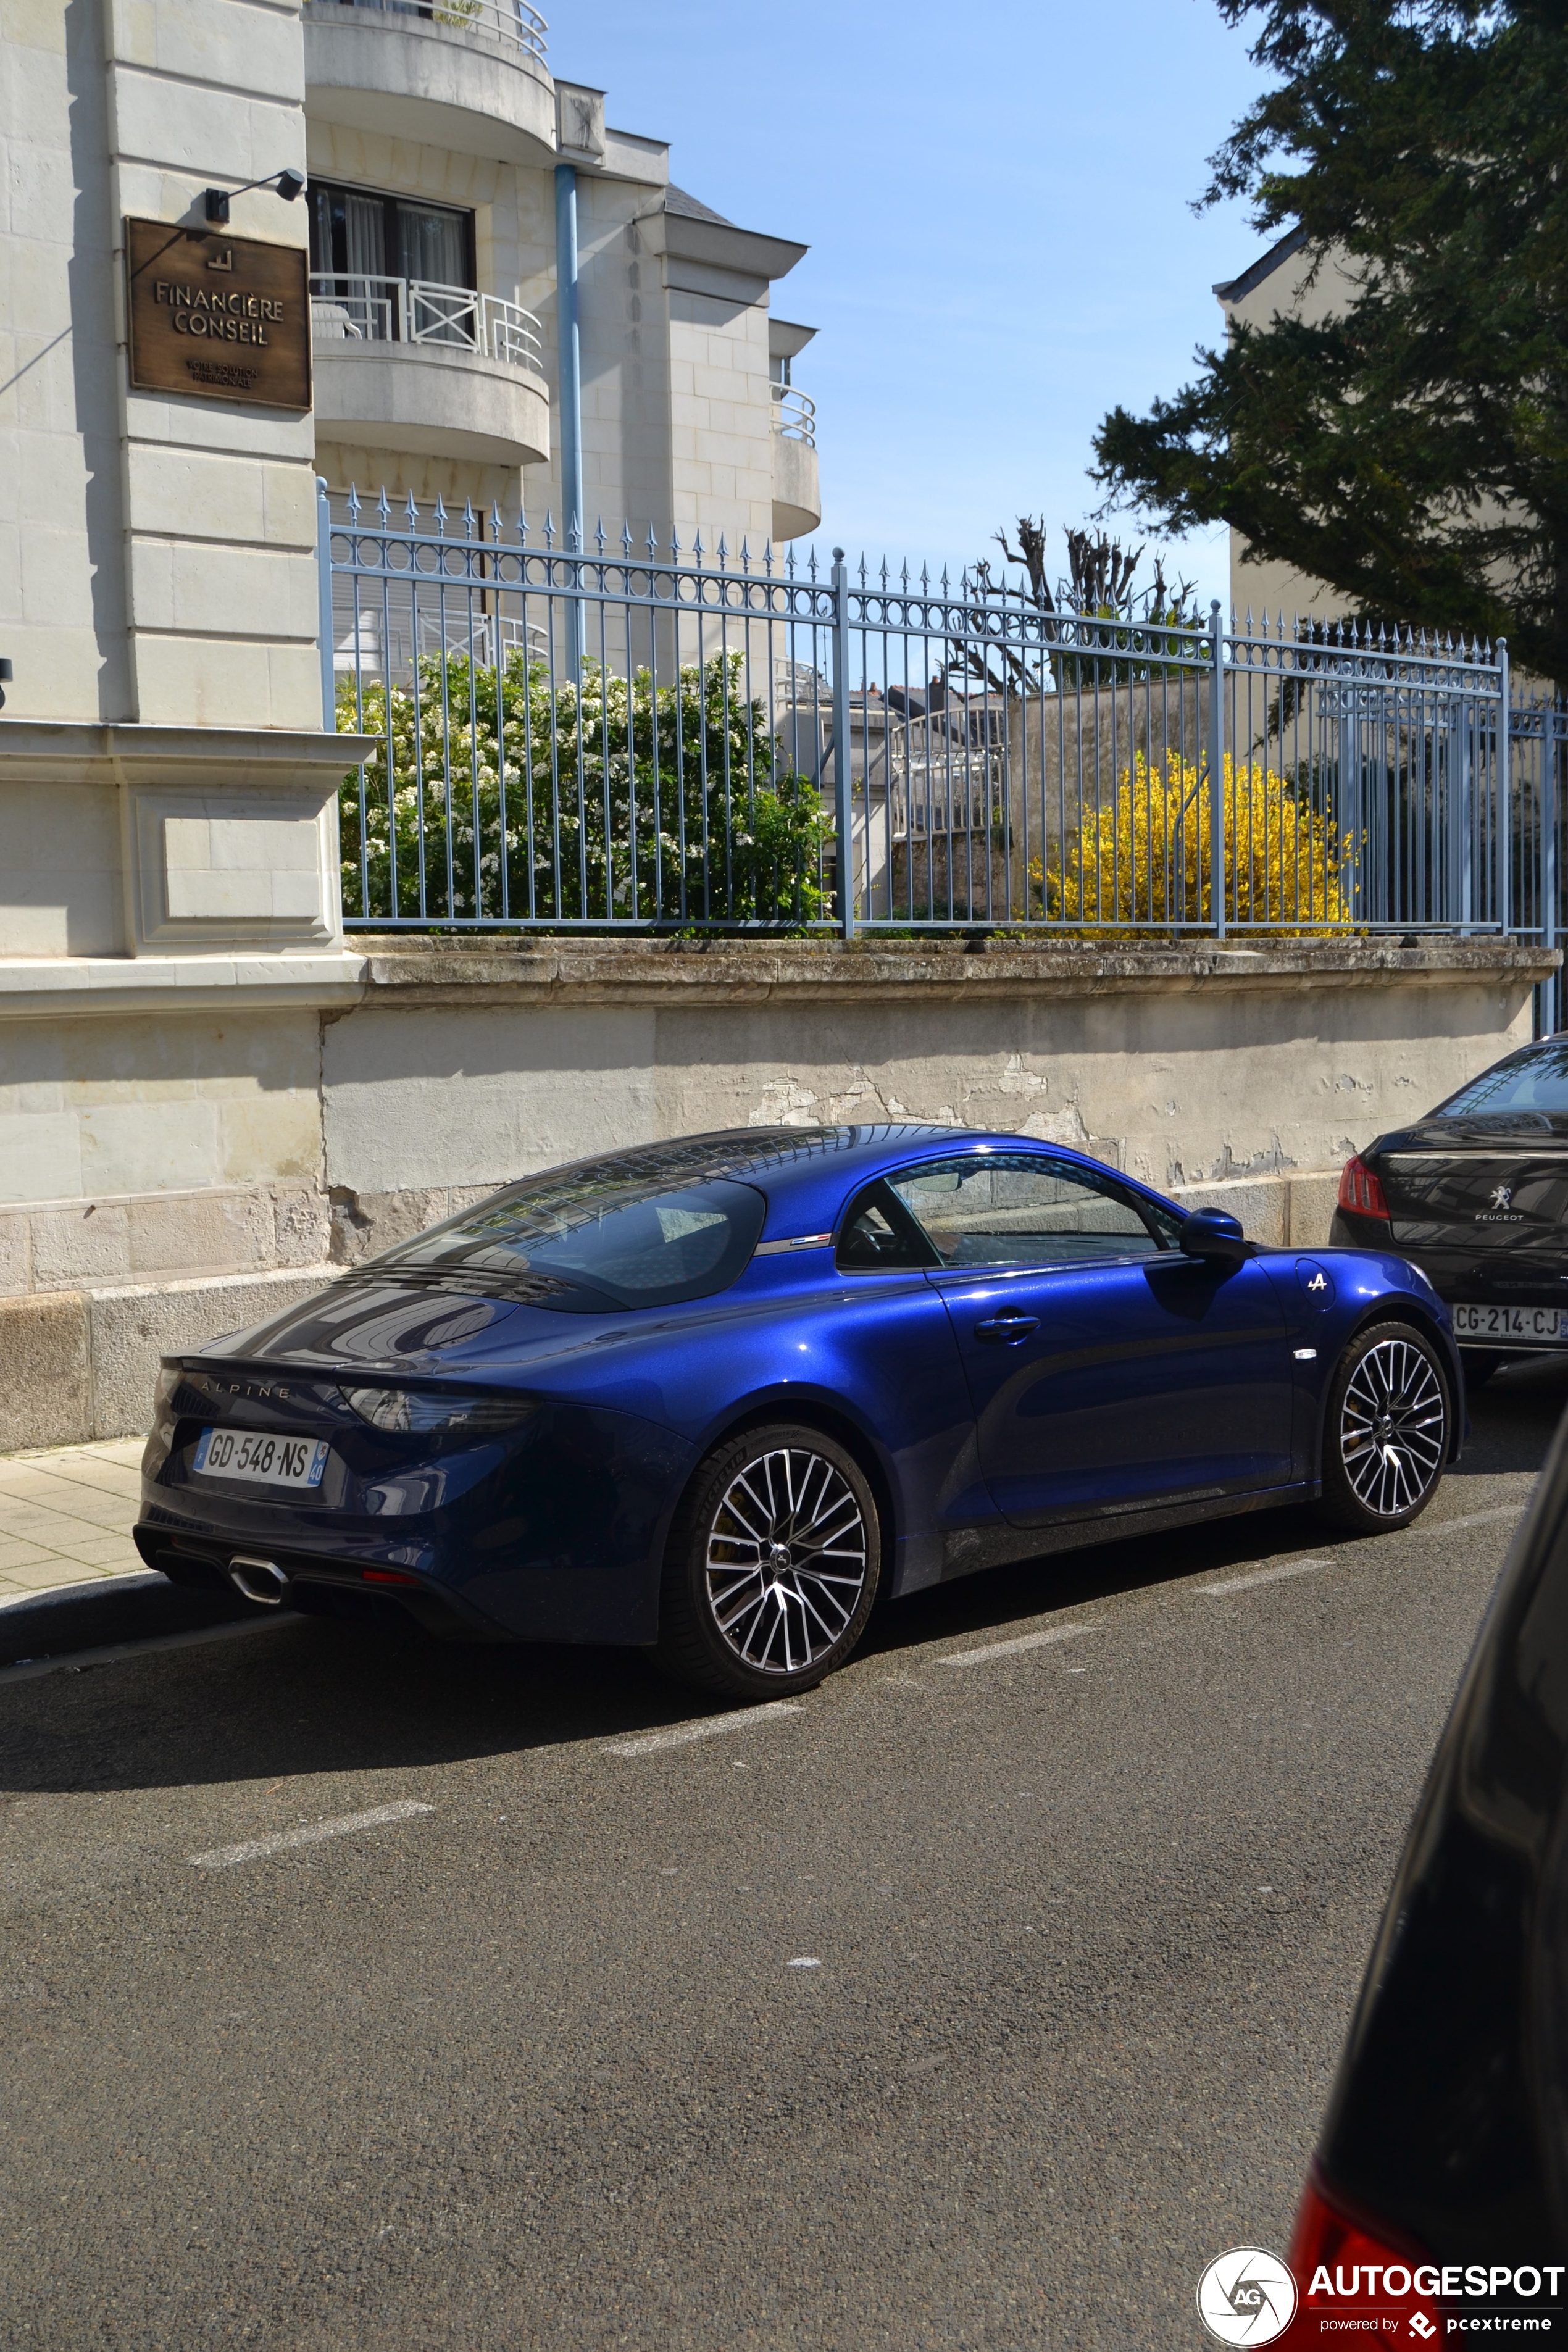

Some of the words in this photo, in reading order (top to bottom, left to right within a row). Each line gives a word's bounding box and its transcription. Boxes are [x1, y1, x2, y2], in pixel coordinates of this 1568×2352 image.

[156, 281, 284, 322] FINANCIÈRE
[173, 311, 269, 346] CONSEIL
[187, 360, 213, 371] VOTRE
[216, 363, 258, 378] SOLUTION
[193, 372, 252, 388] PATRIMONIALE
[1456, 1306, 1559, 1335] CG-214-CJ
[201, 1381, 290, 1399] ALPINE
[197, 1453, 204, 1462] F
[208, 1433, 309, 1478] GD-548-NS
[309, 1464, 323, 1482] 40
[699, 1450, 745, 1524] MICHELIN
